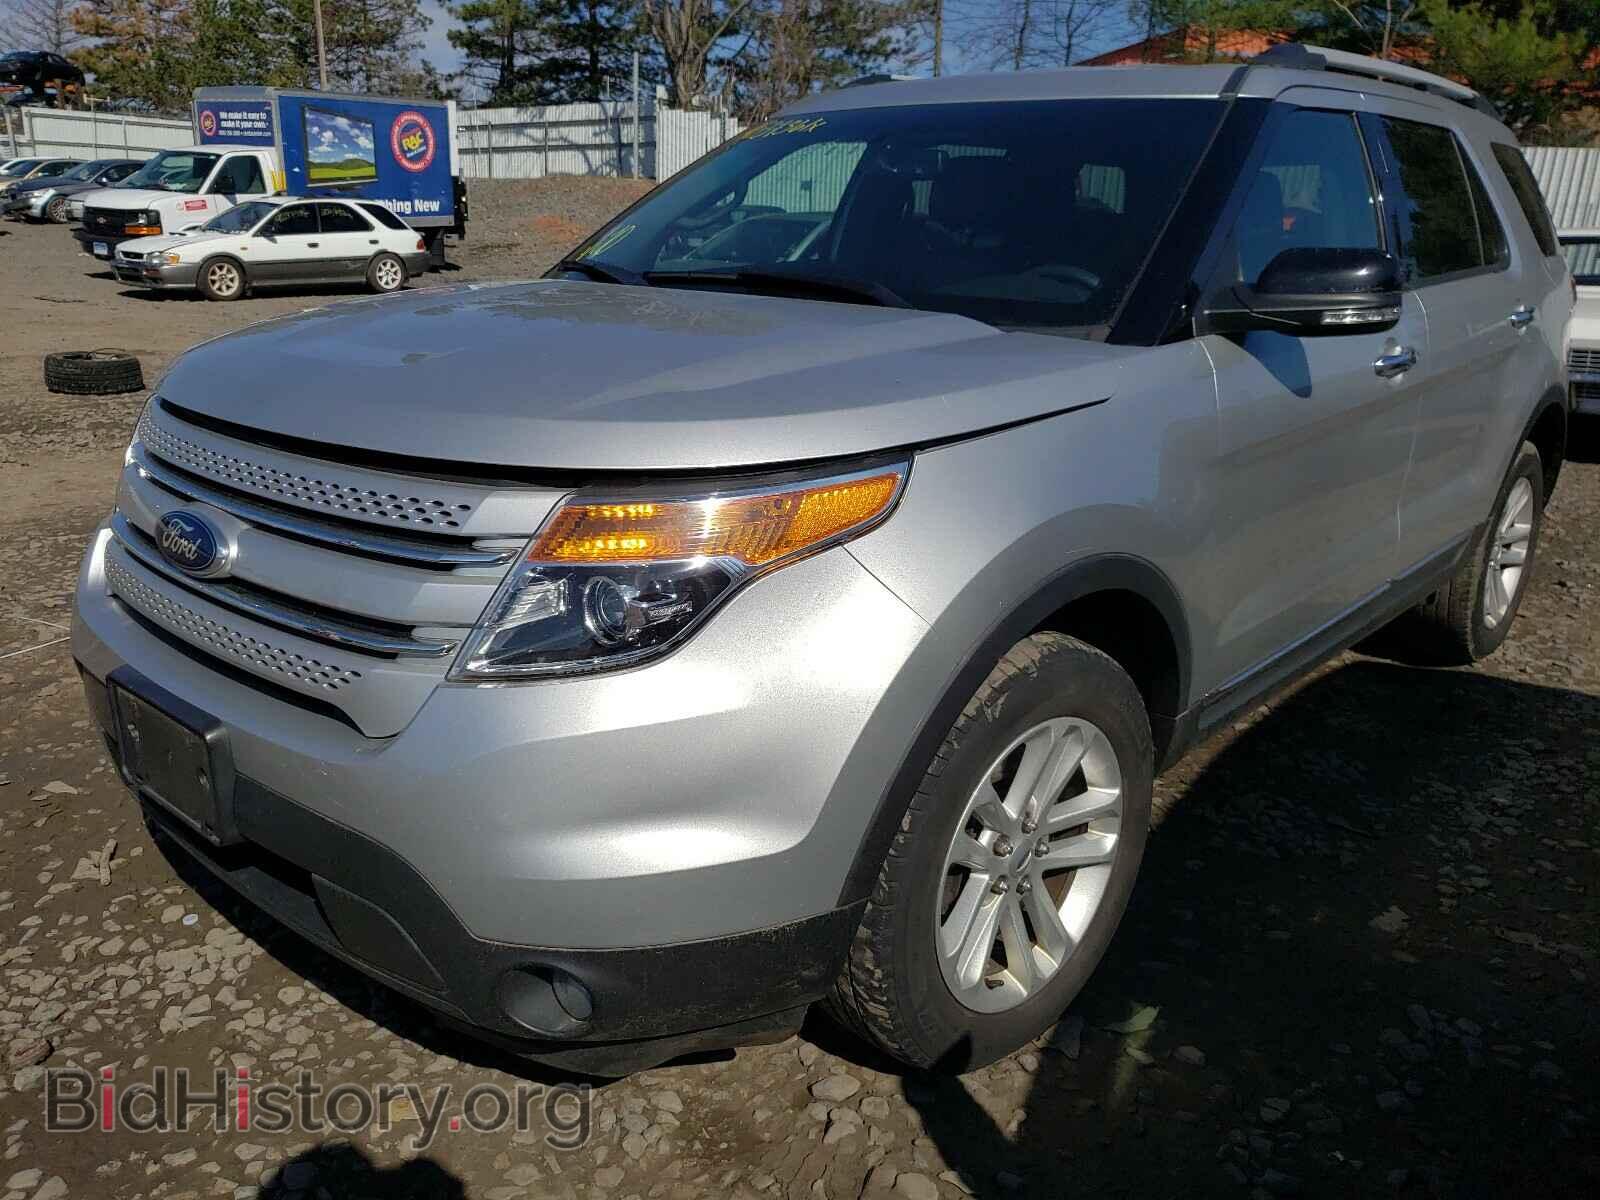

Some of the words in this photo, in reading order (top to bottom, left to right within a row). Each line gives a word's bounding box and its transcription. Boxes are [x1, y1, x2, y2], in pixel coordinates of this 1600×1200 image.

[248, 112, 259, 120] easy
[221, 120, 236, 128] make
[402, 130, 425, 151] RAC
[415, 199, 440, 211] New
[162, 518, 202, 560] Ford
